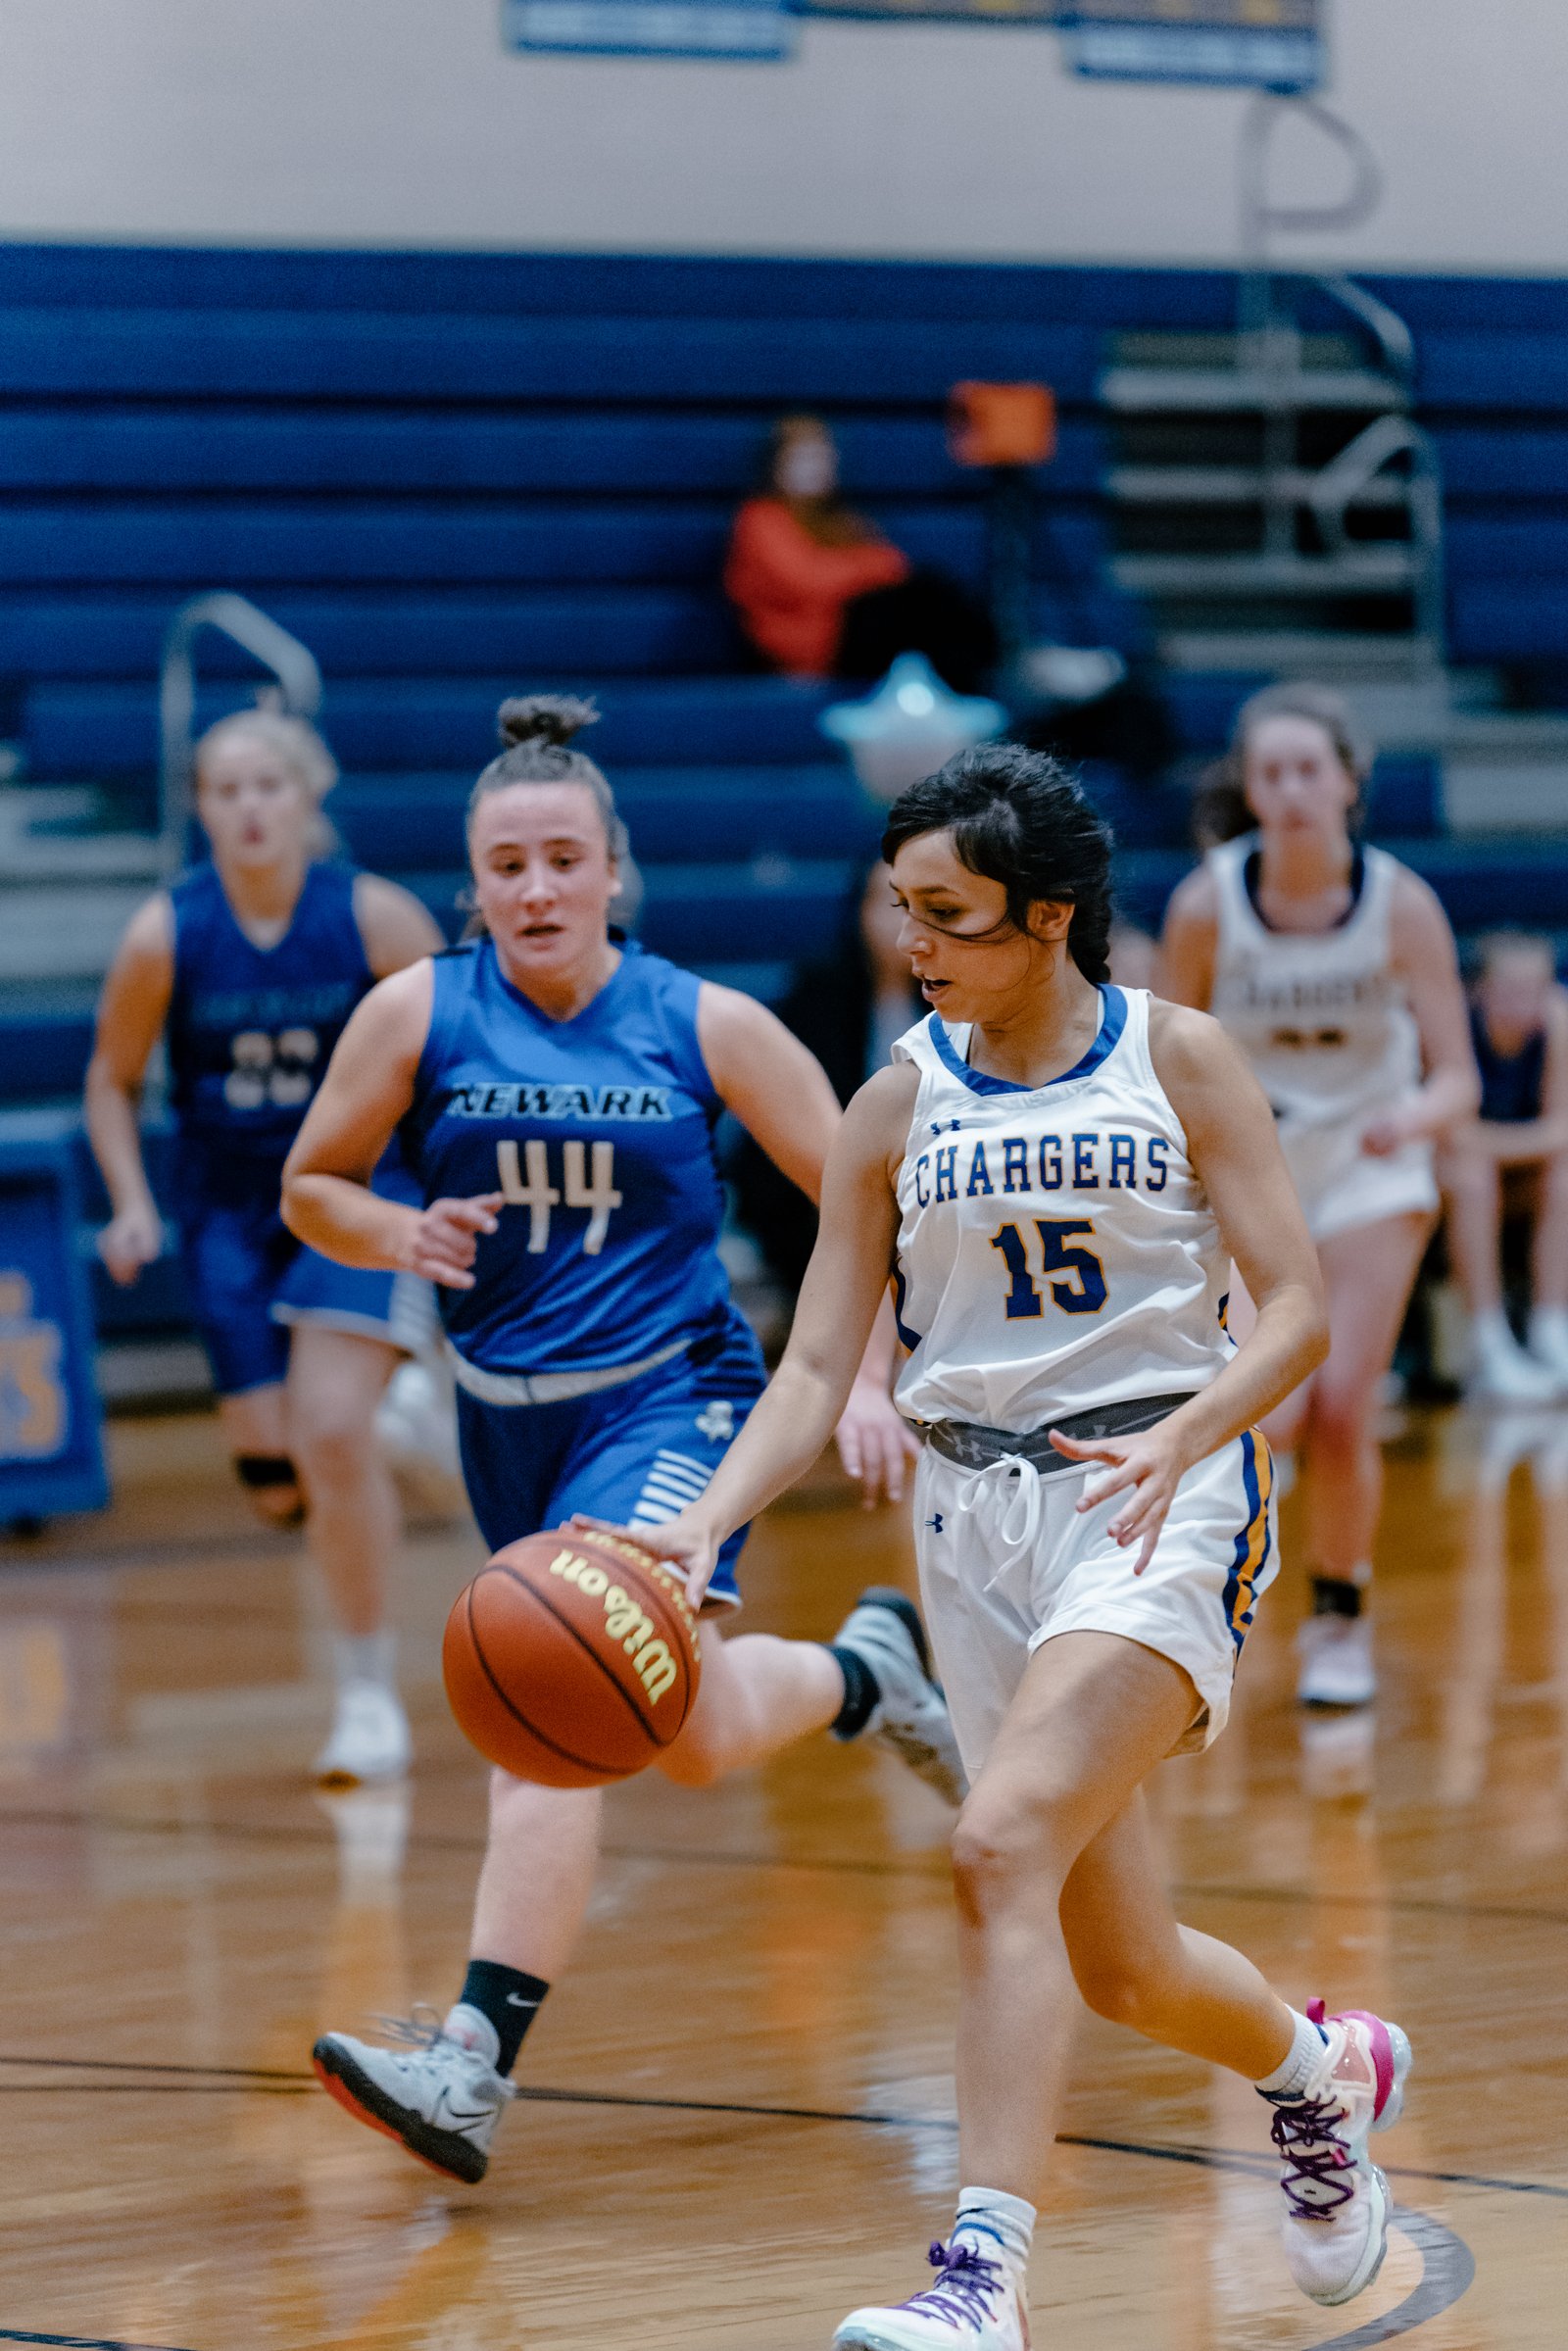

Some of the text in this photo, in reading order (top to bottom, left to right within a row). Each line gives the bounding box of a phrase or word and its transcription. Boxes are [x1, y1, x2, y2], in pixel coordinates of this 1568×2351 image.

[445, 1081, 674, 1122] NEWARK
[496, 1140, 622, 1255] 44
[914, 1133, 1169, 1208] CHARGERS
[989, 1218, 1109, 1321] 15
[549, 1549, 677, 1707] Wilson
